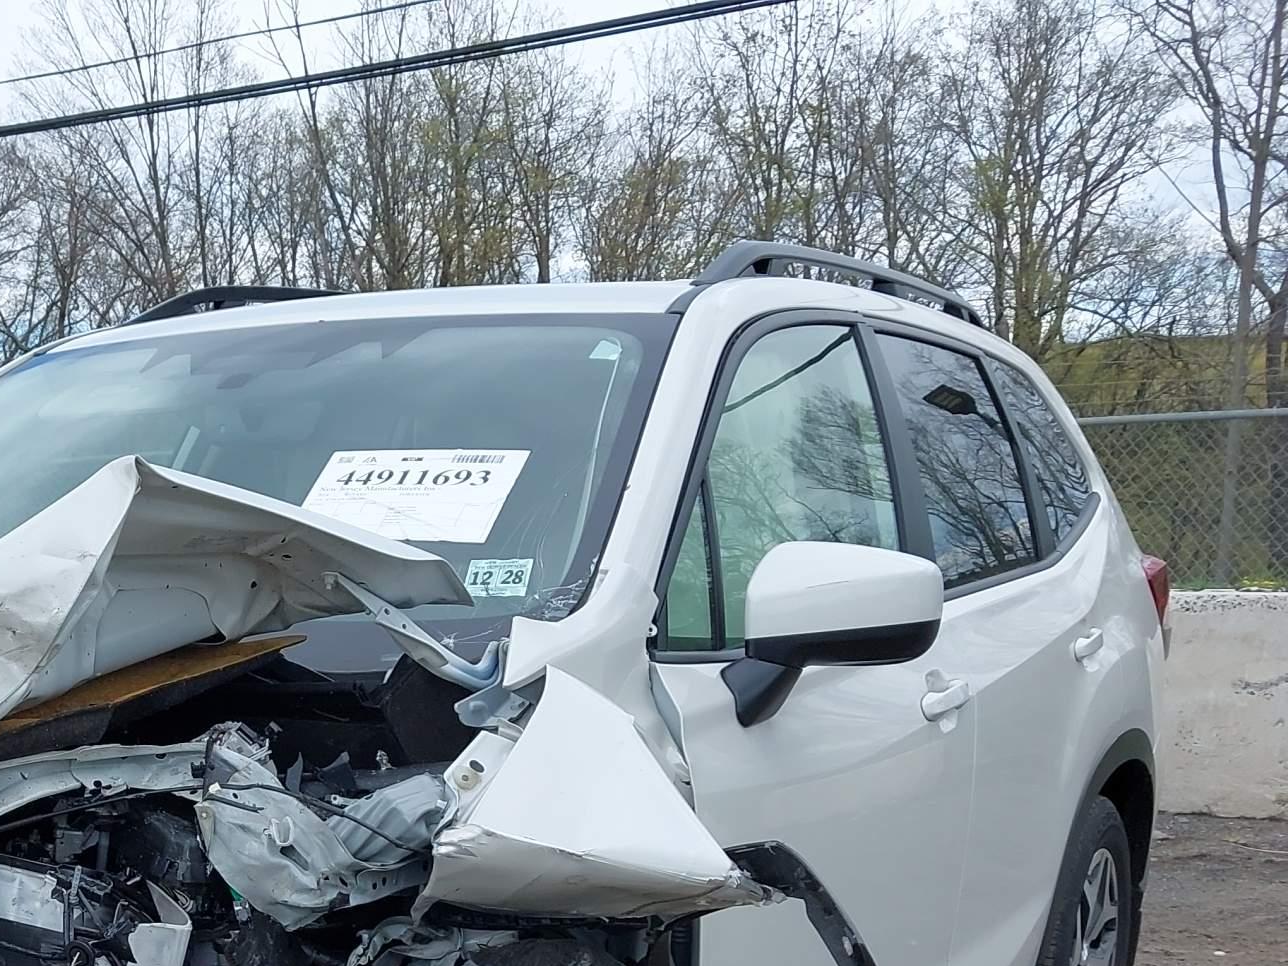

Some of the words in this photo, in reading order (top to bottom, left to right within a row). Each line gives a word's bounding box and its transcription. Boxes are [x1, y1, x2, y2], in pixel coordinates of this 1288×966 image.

[335, 469, 492, 486] 44911693
[469, 570, 493, 586] 12
[500, 569, 524, 585] 28
